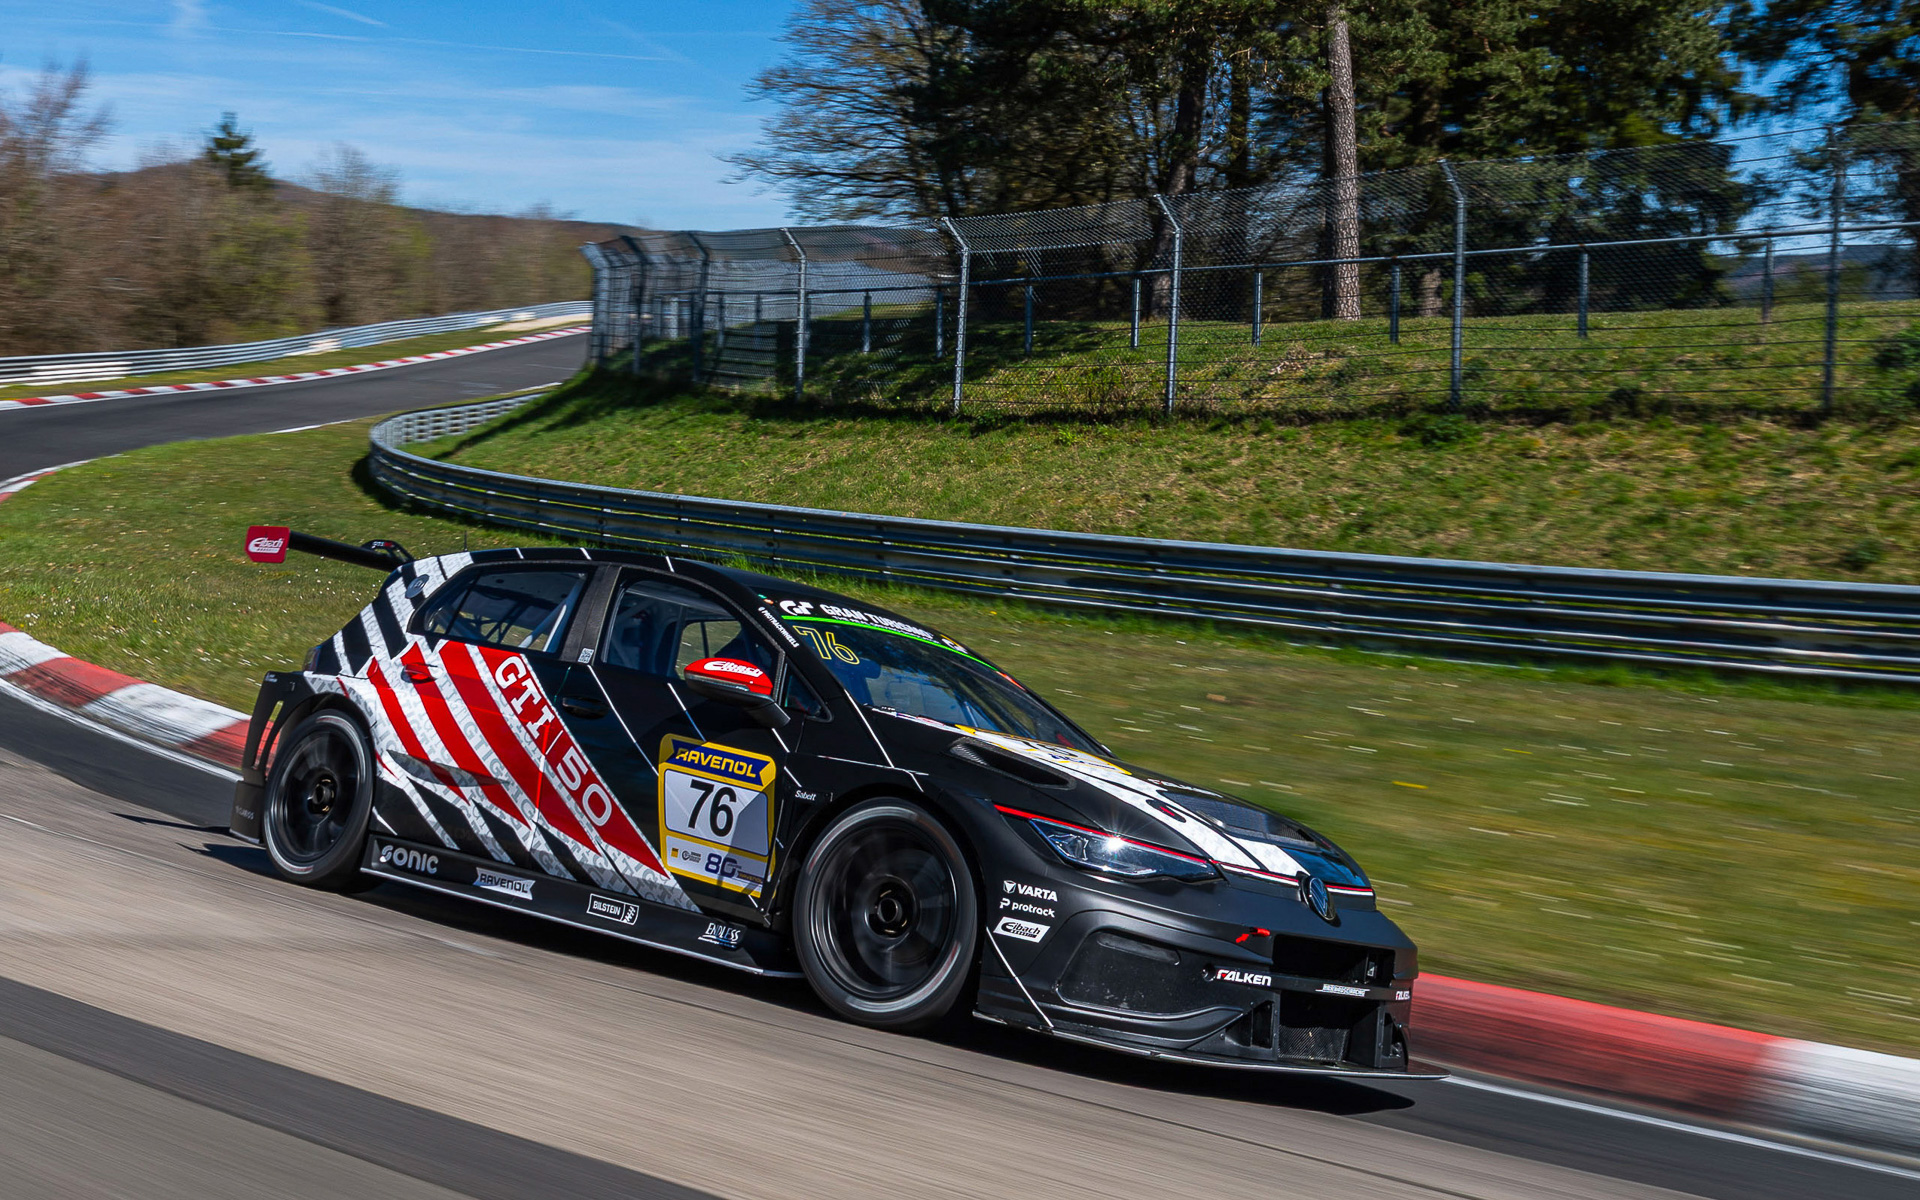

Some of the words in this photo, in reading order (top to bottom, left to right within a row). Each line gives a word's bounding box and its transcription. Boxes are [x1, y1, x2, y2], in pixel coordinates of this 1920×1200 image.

[820, 604, 868, 621] GRAN
[792, 625, 861, 665] 76
[494, 655, 557, 739] GTI
[556, 746, 613, 827] 50
[675, 747, 757, 778] RAVENOL
[687, 779, 737, 837] 76
[380, 845, 438, 873] SONIC
[479, 873, 529, 894] RAVENOL
[1017, 883, 1058, 902] VARTA
[592, 900, 621, 916] BILSTEIN
[1011, 902, 1056, 918] protrack
[704, 922, 741, 942] ENDLESS
[1001, 922, 1041, 935] Eibach
[1216, 969, 1272, 987] FALKEN
